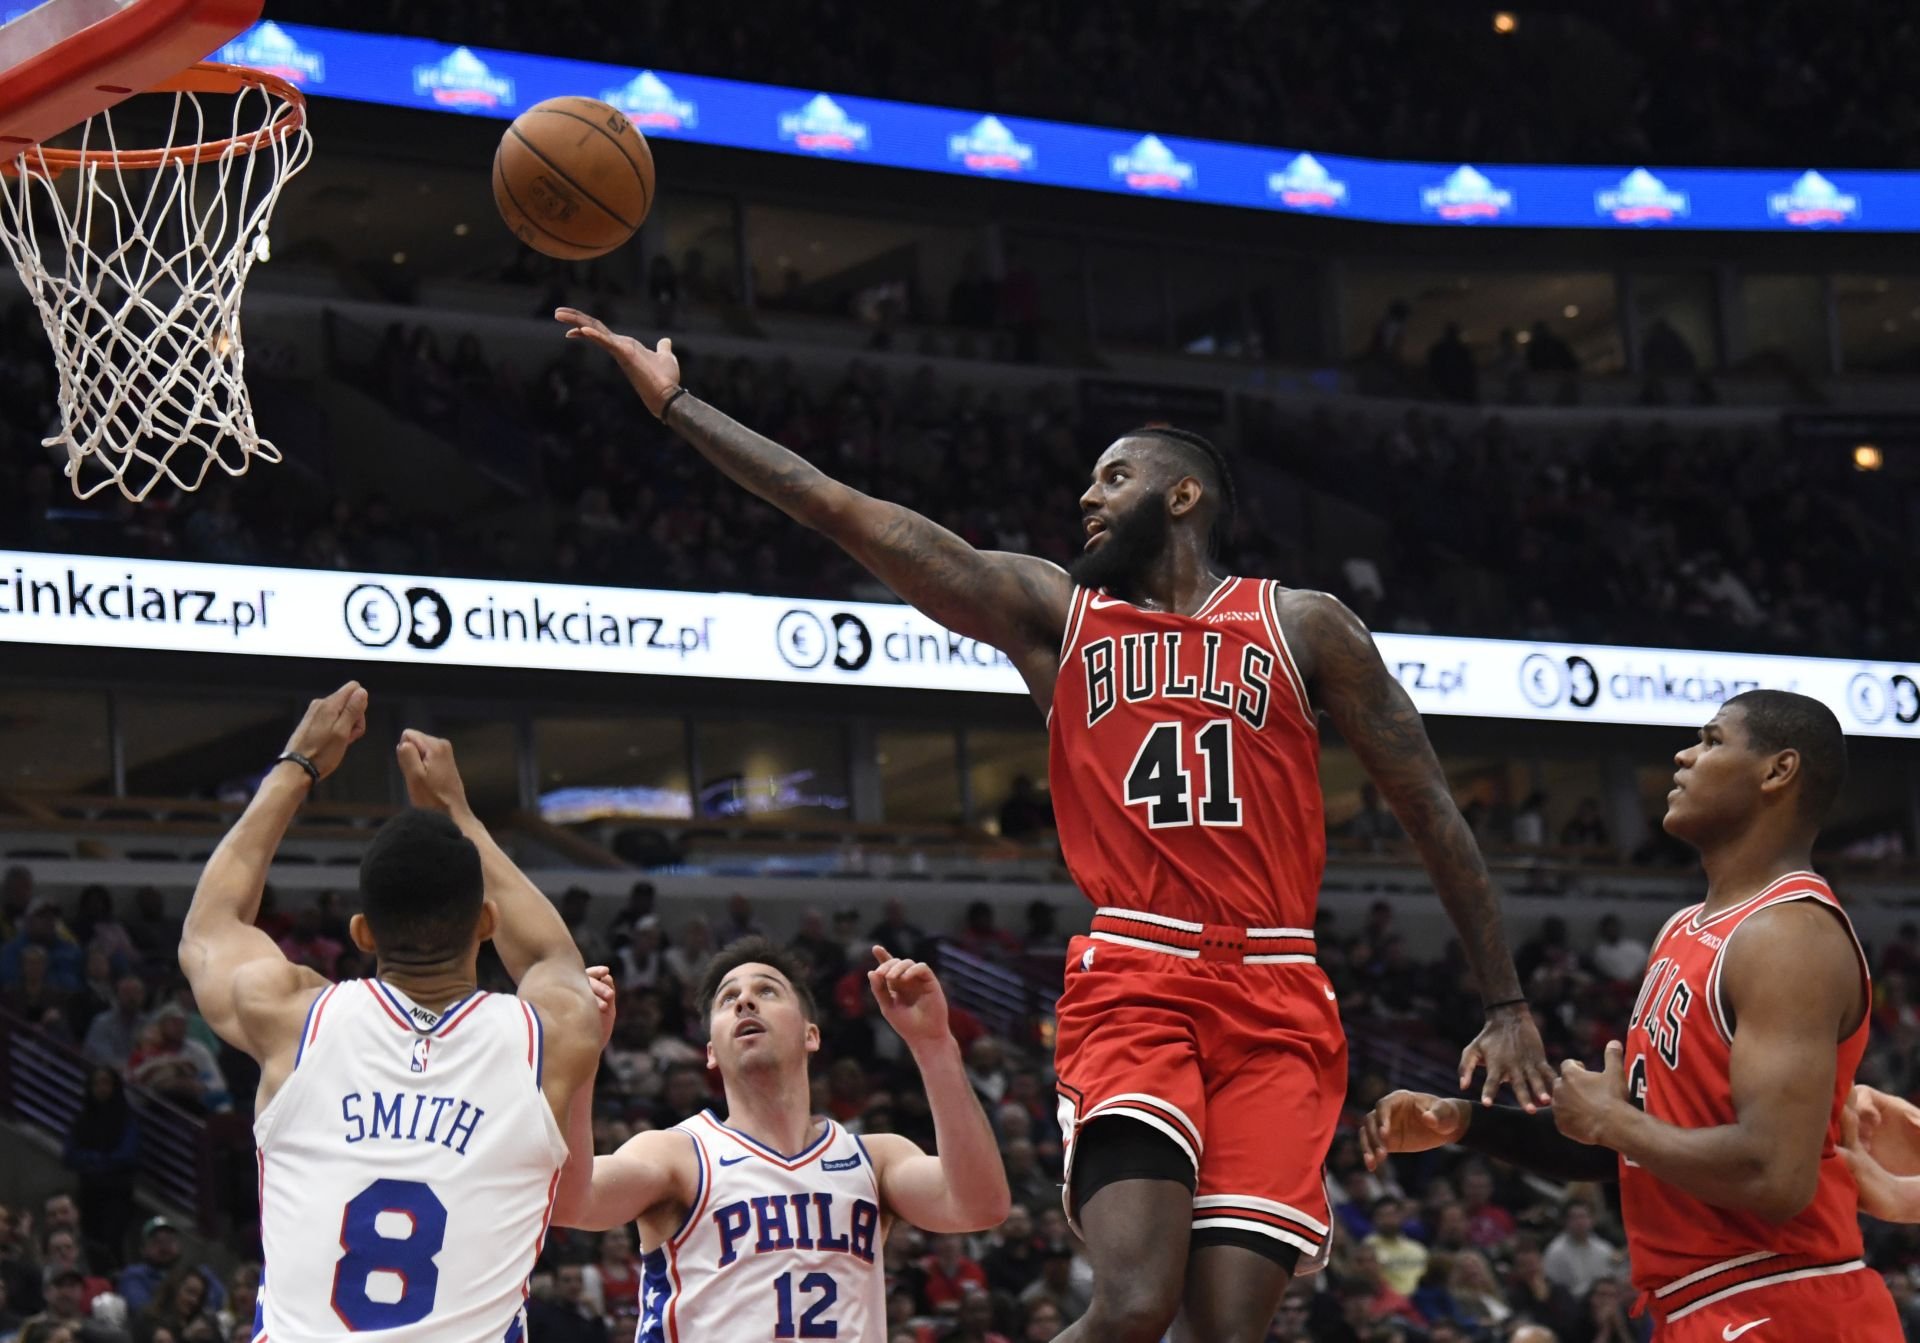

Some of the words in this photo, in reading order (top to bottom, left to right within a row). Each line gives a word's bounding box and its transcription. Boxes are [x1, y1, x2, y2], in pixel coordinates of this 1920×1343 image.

[464, 597, 711, 657] cinkciarz.pl
[1082, 632, 1274, 731] BULLS
[1124, 719, 1243, 829] 41
[409, 1007, 438, 1026] NIKE
[342, 1091, 484, 1156] SMITH
[330, 1178, 448, 1332] 8
[713, 1193, 879, 1269] PHILA
[774, 1272, 837, 1339] 12
